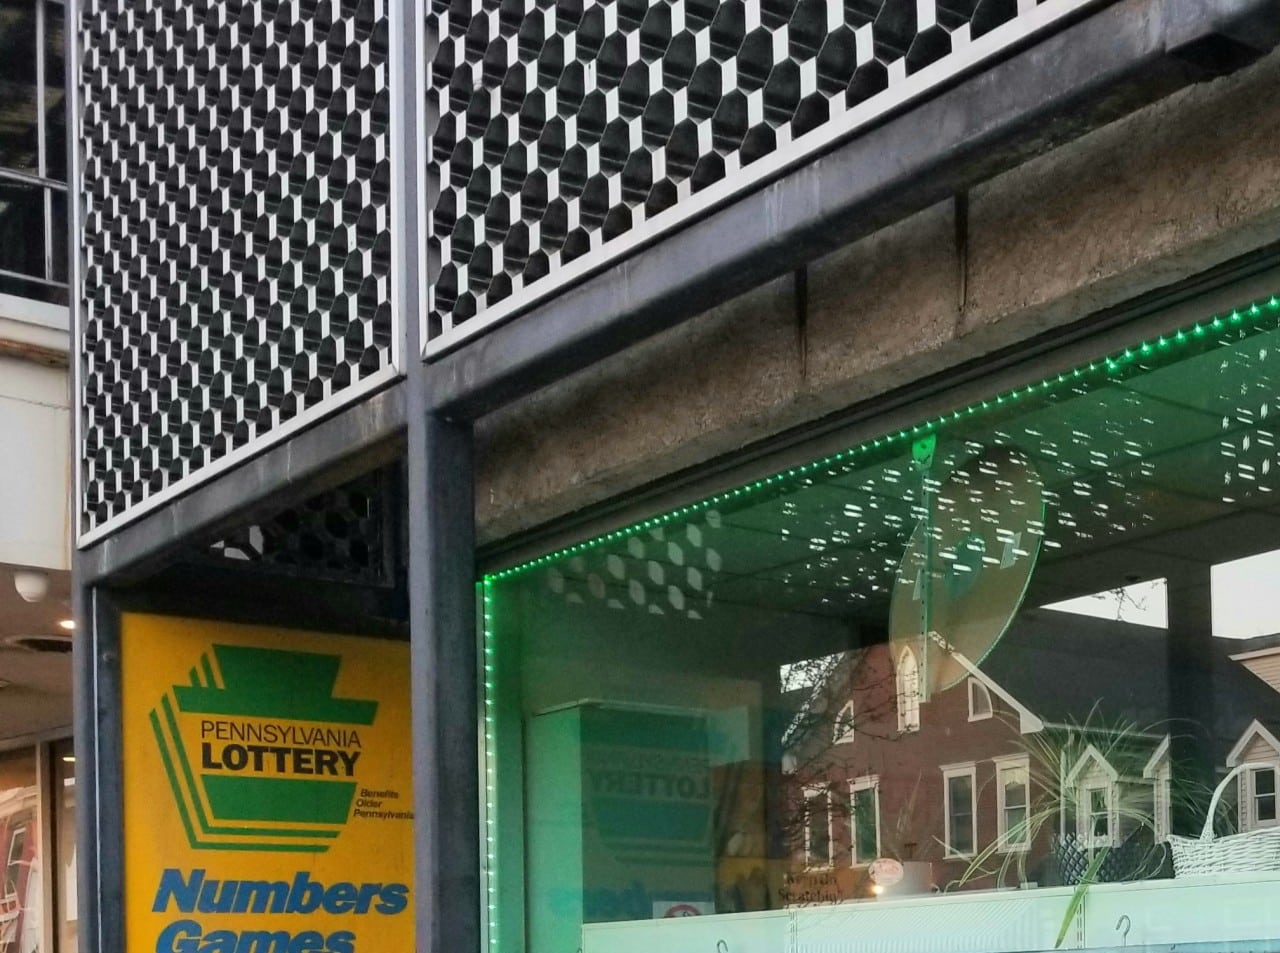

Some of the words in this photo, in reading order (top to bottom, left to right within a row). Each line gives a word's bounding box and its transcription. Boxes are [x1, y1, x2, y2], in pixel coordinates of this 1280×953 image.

[201, 720, 362, 748] PENNSYLVANIA
[202, 742, 361, 777] LOTTERY
[356, 799, 382, 808] Older
[361, 788, 399, 800] Benefits
[151, 868, 410, 915] Numbers
